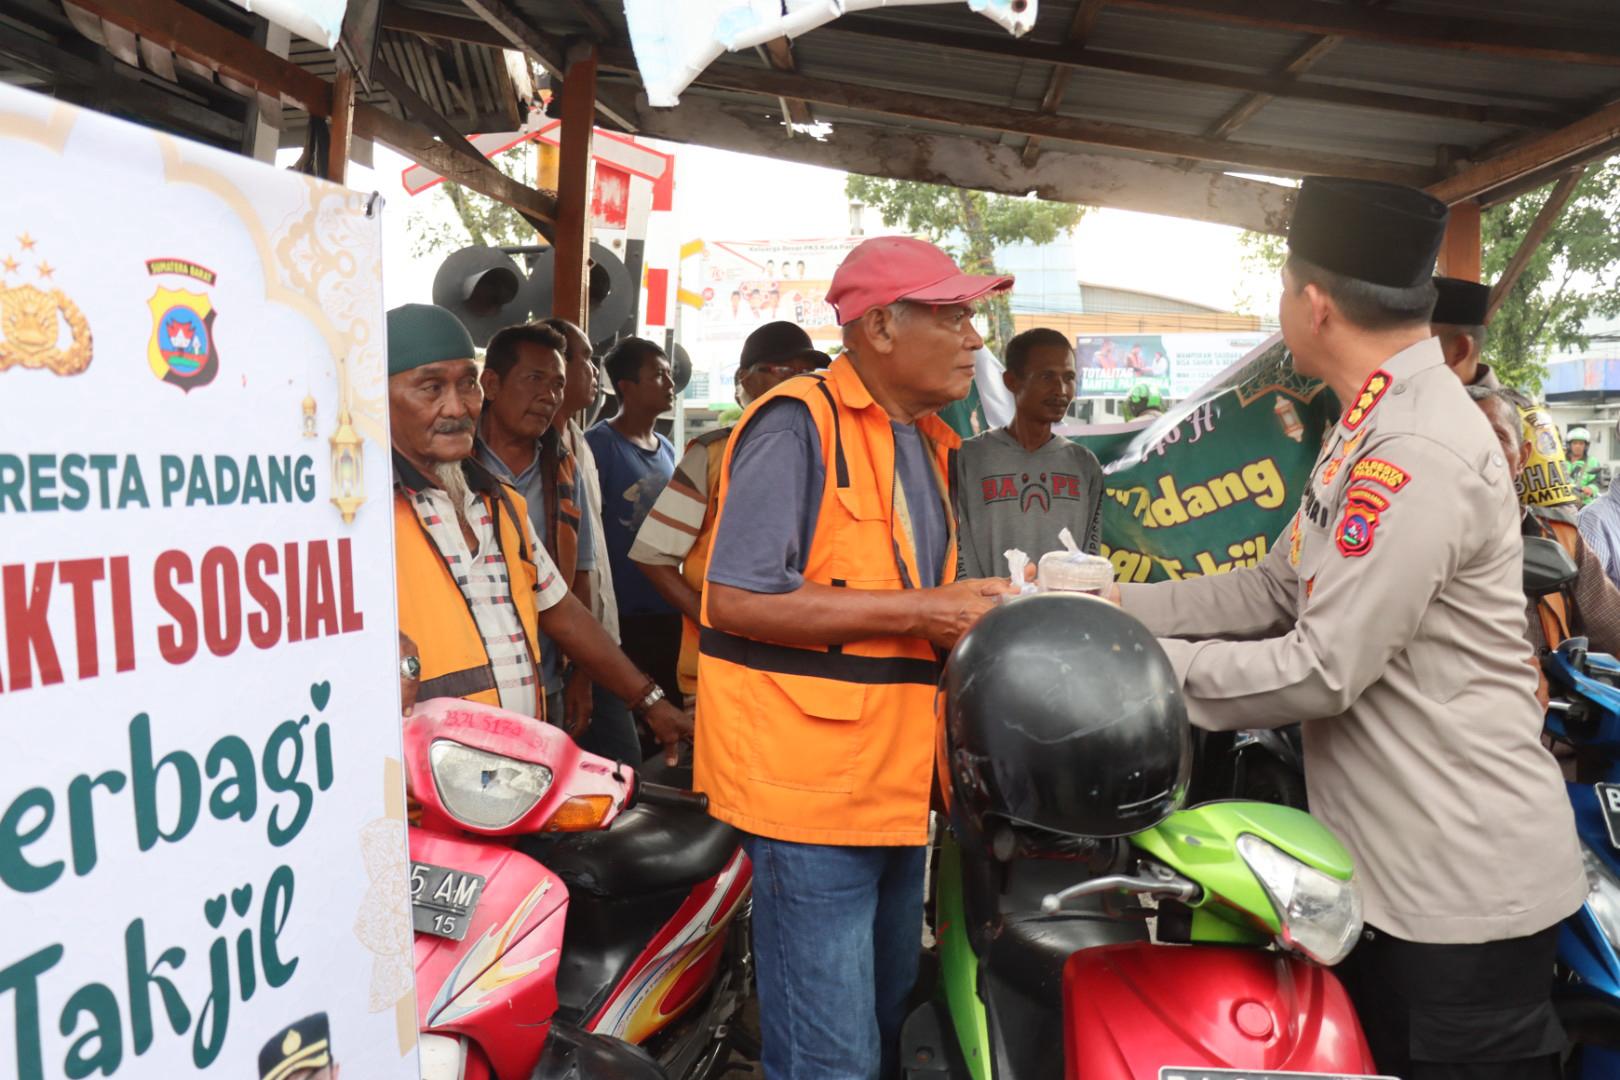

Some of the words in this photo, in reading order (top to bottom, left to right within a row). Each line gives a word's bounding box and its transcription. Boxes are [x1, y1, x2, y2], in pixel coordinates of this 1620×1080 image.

[0, 454, 149, 514] RESTA
[161, 455, 316, 508] PADANG
[153, 538, 364, 666] SOSIAL
[0, 681, 334, 893] erbagi
[410, 864, 431, 895] 5
[433, 872, 479, 907] AM
[434, 914, 457, 934] 15
[0, 865, 299, 1080] Takjil
